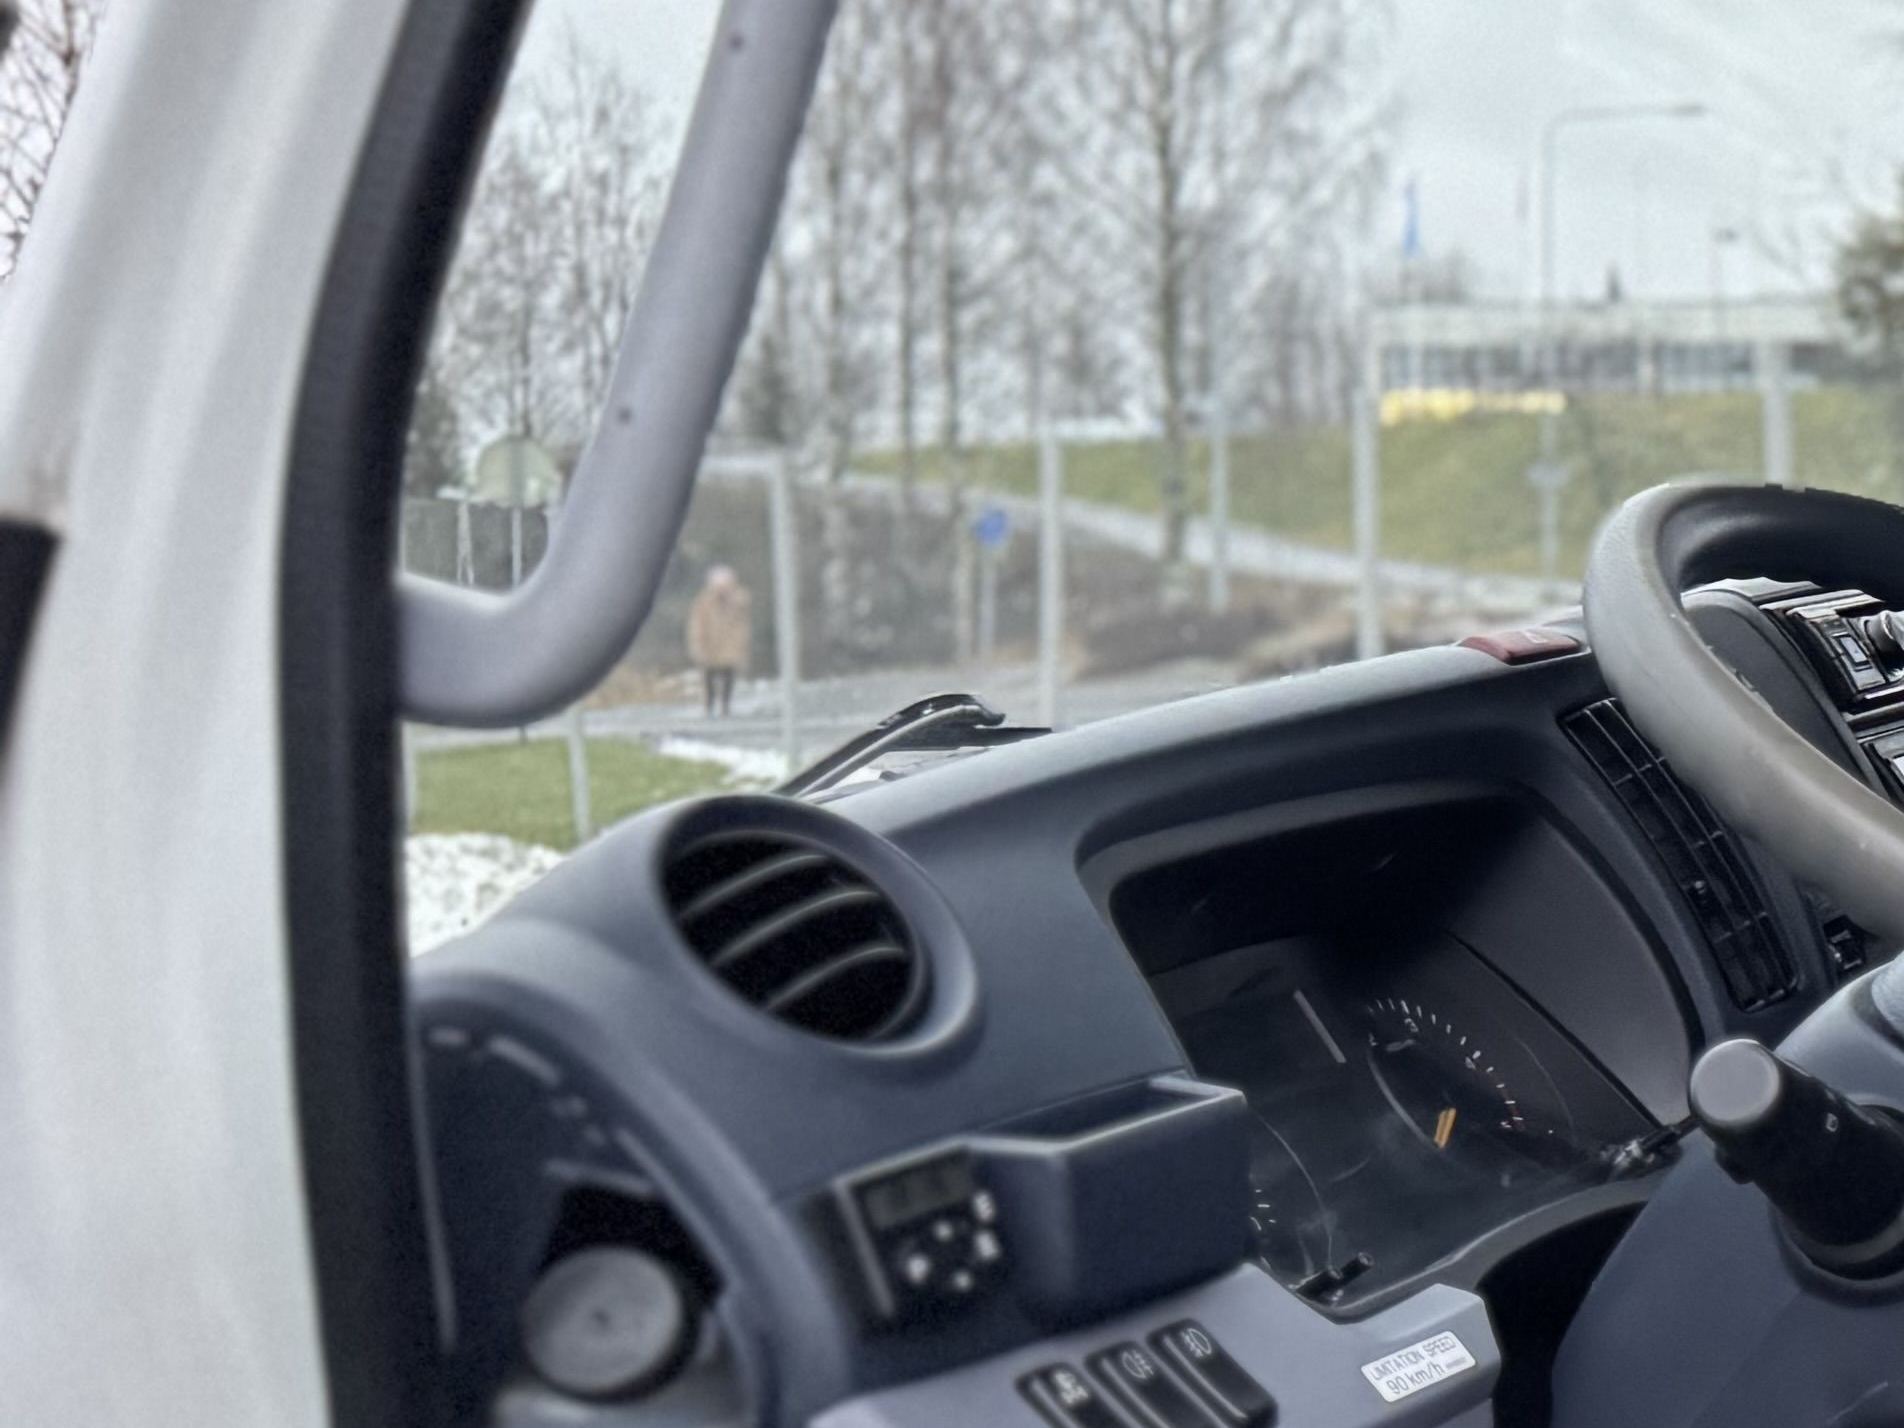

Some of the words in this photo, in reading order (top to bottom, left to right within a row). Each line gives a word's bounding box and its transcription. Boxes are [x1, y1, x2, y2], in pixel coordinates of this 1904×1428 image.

[1369, 1350, 1425, 1381] LIMITATION
[1422, 1335, 1457, 1358] SPEED
[1386, 1375, 1409, 1395] 90
[1404, 1361, 1446, 1387] km/h
